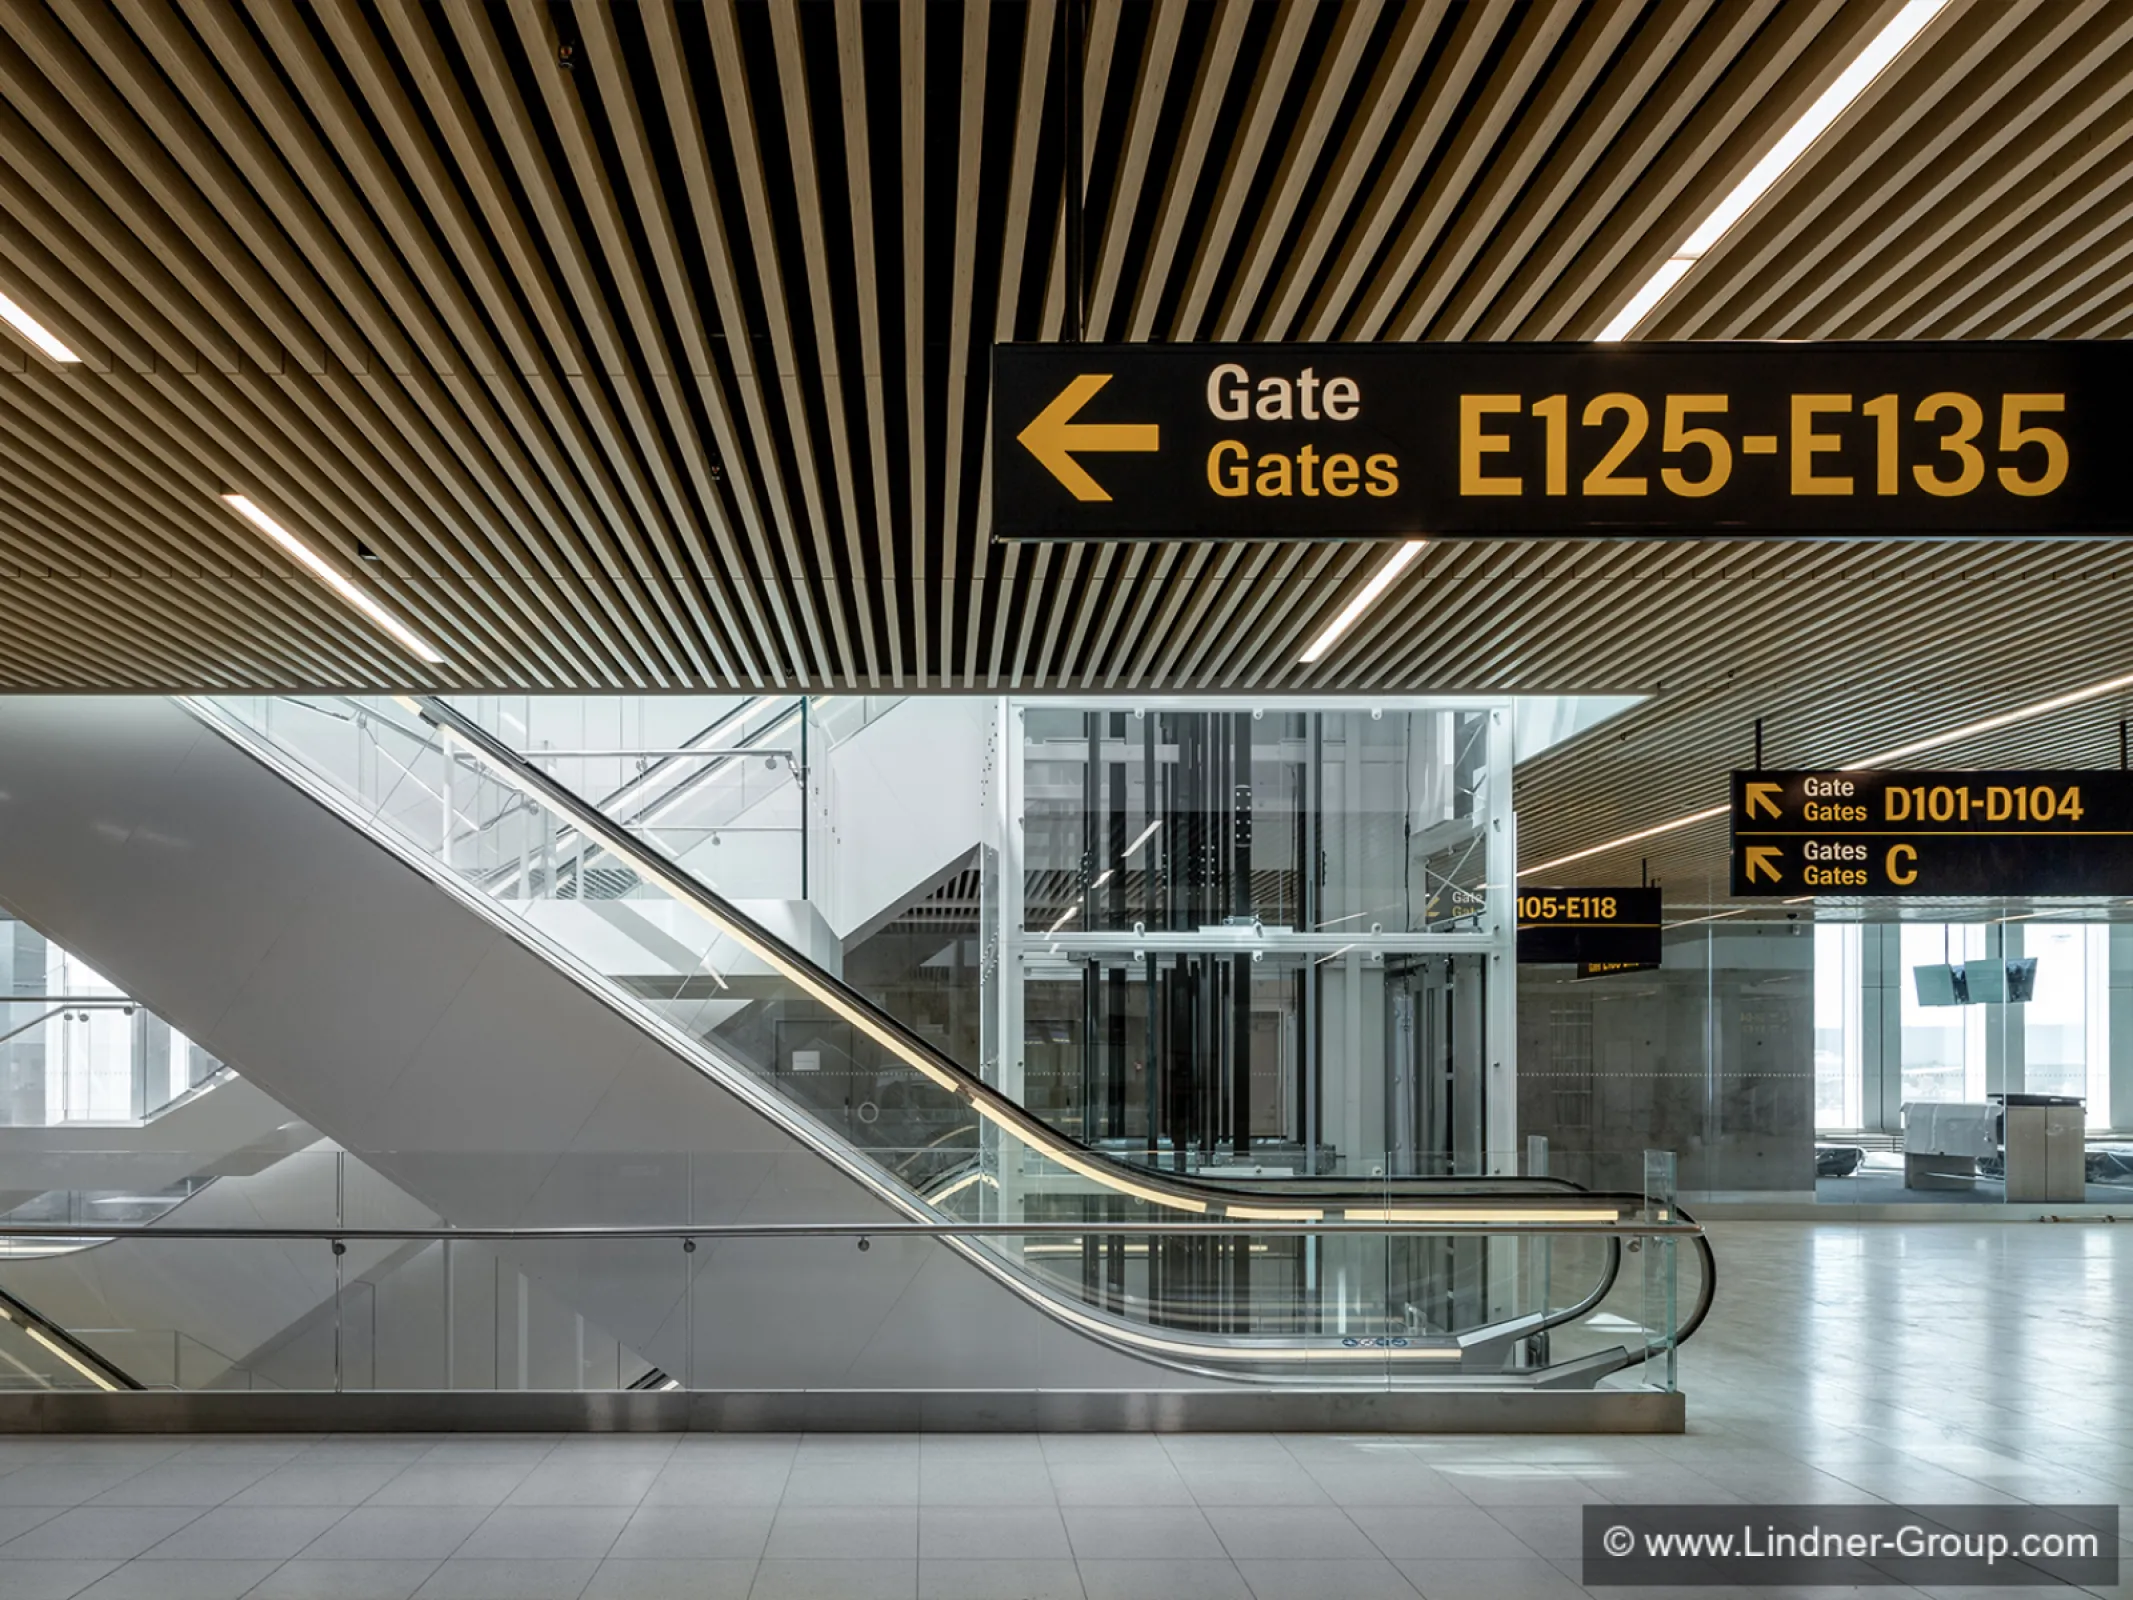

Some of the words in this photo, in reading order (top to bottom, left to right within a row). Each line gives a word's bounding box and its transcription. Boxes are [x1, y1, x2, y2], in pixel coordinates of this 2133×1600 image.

[1207, 364, 1360, 421] Gate
[1459, 391, 2070, 498] E125-E135
[1207, 440, 1399, 498] Gates
[1804, 777, 1855, 797] Gate
[1885, 786, 2085, 822] D101-D104
[1804, 801, 1868, 822] Gates
[1804, 841, 1868, 861] Gates
[1885, 844, 1919, 886] C
[1804, 865, 1868, 885] Gates
